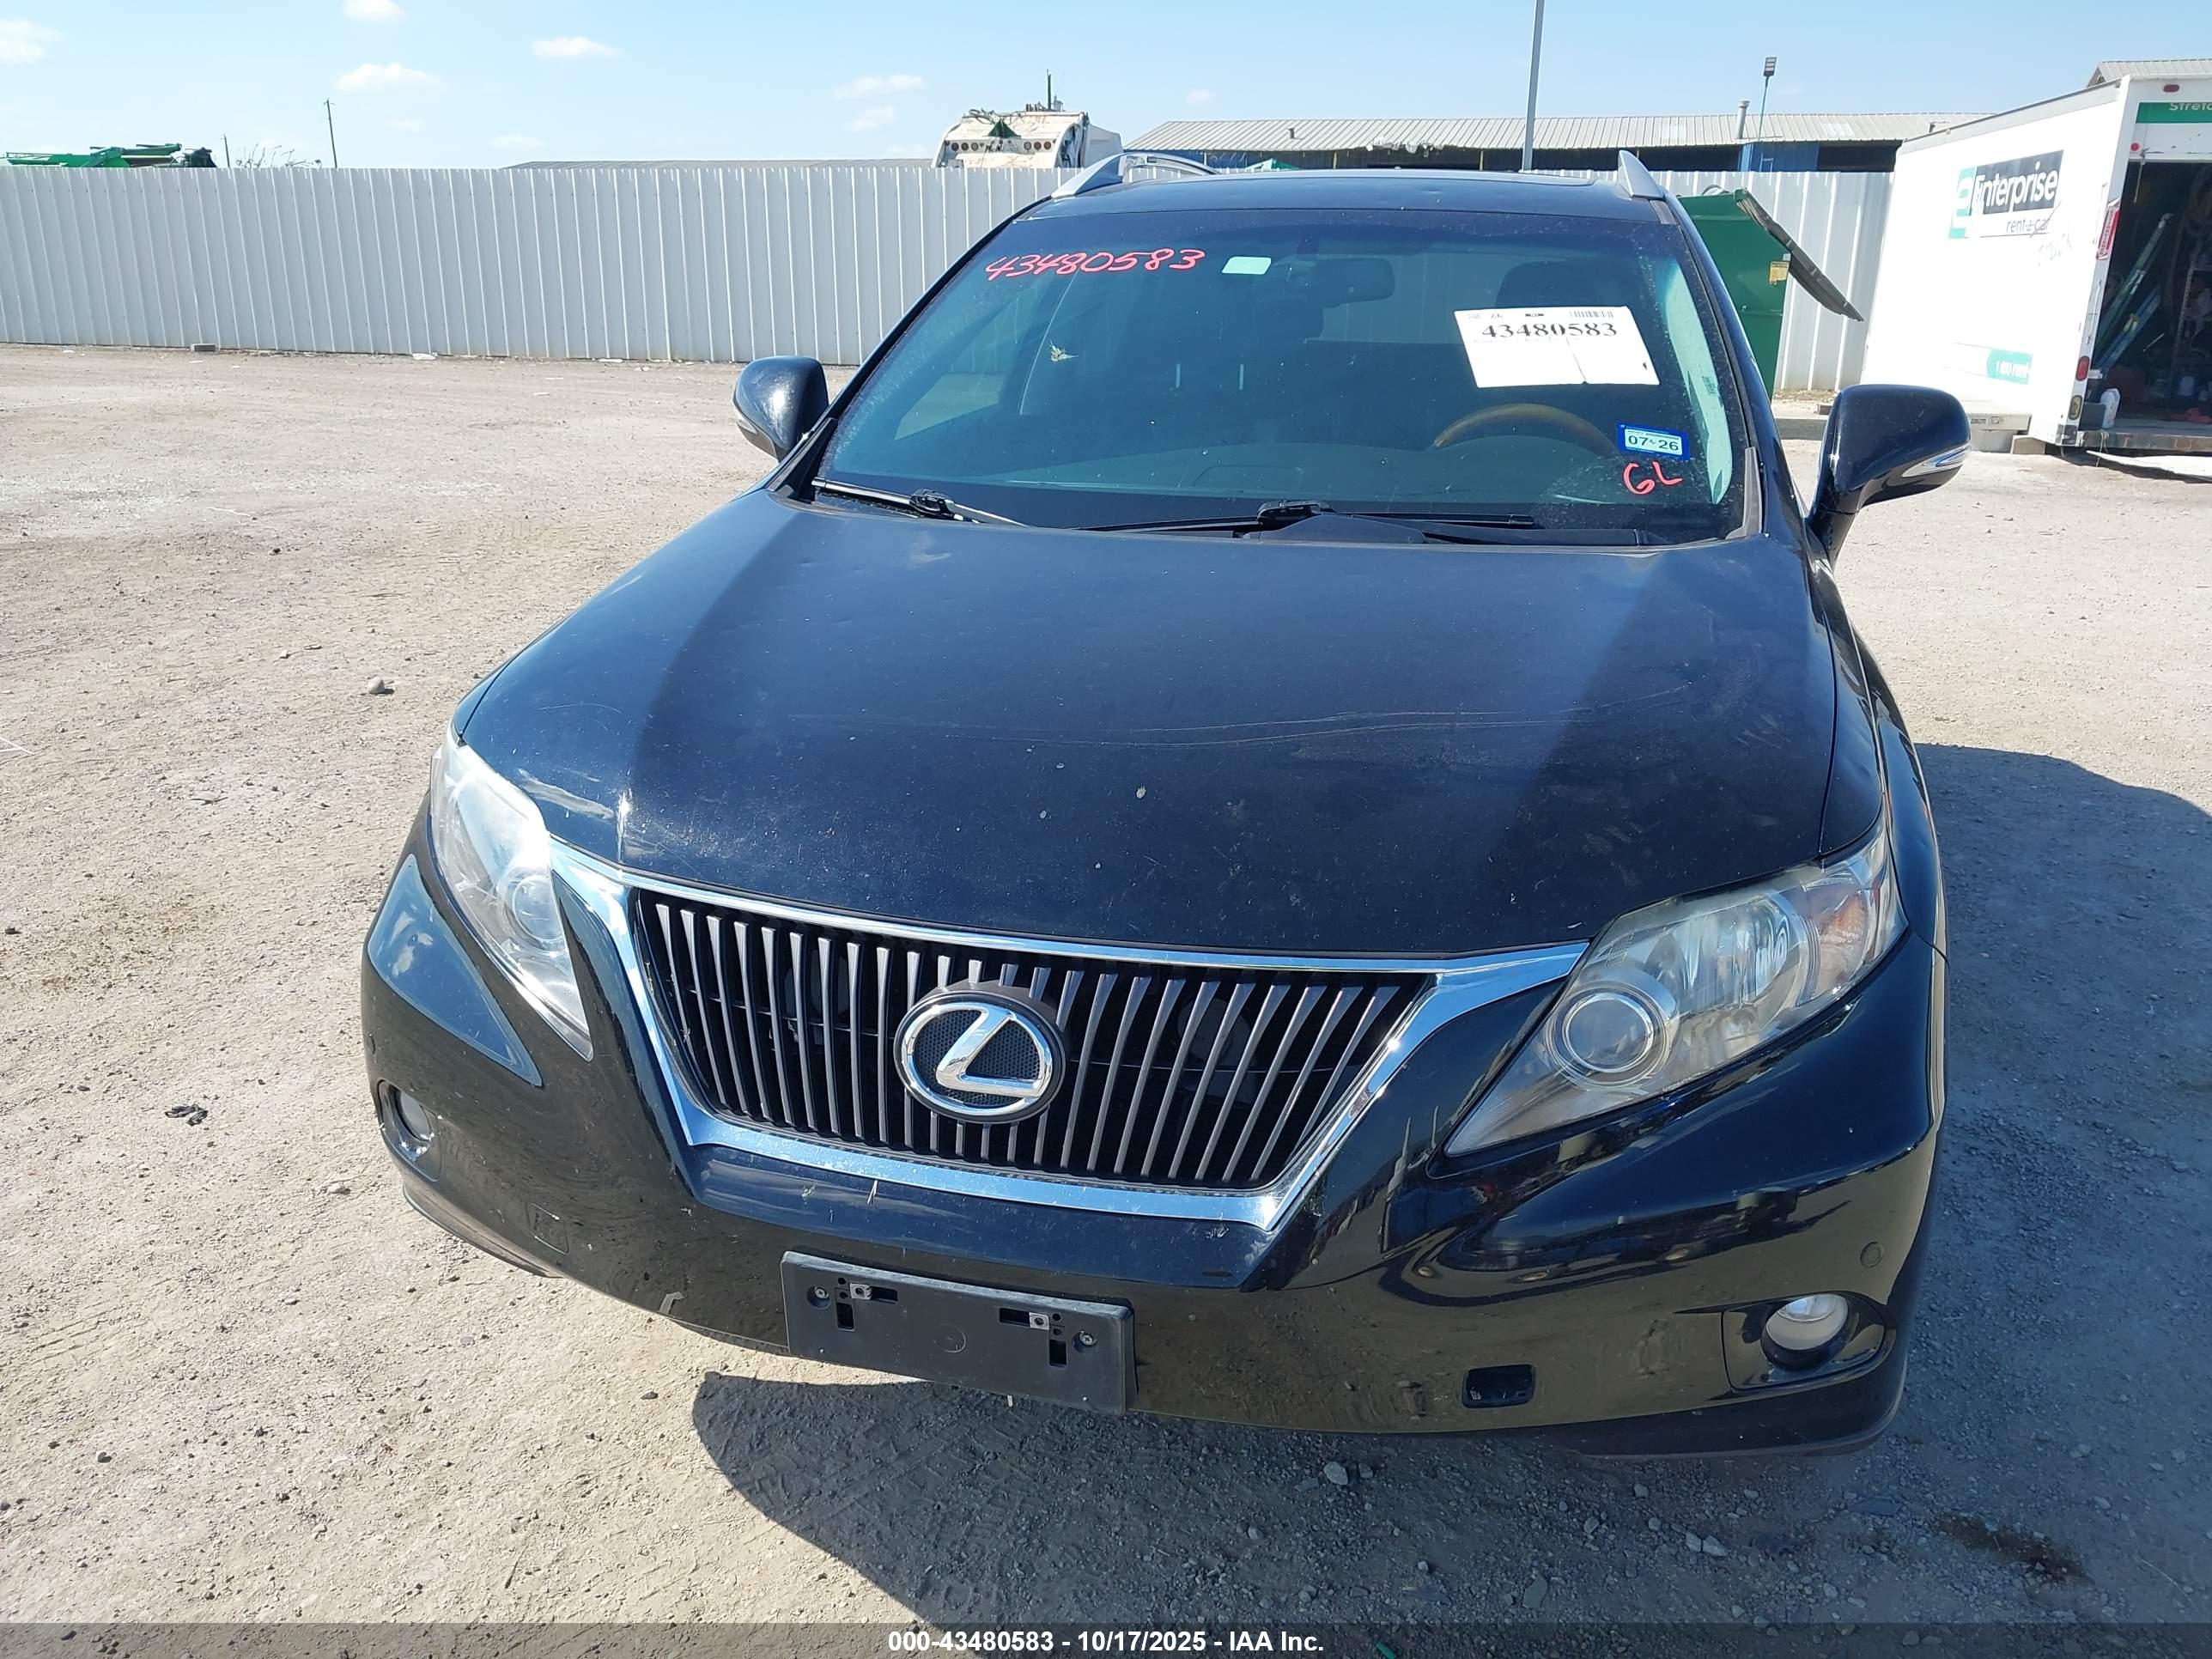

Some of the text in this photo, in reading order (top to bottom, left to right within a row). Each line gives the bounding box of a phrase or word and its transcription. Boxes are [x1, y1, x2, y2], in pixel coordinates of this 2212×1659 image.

[1974, 161, 2059, 215] Enterprise
[985, 248, 1206, 281] 43480583
[1482, 322, 1617, 337] 43480583
[1628, 435, 1679, 451] 07 26
